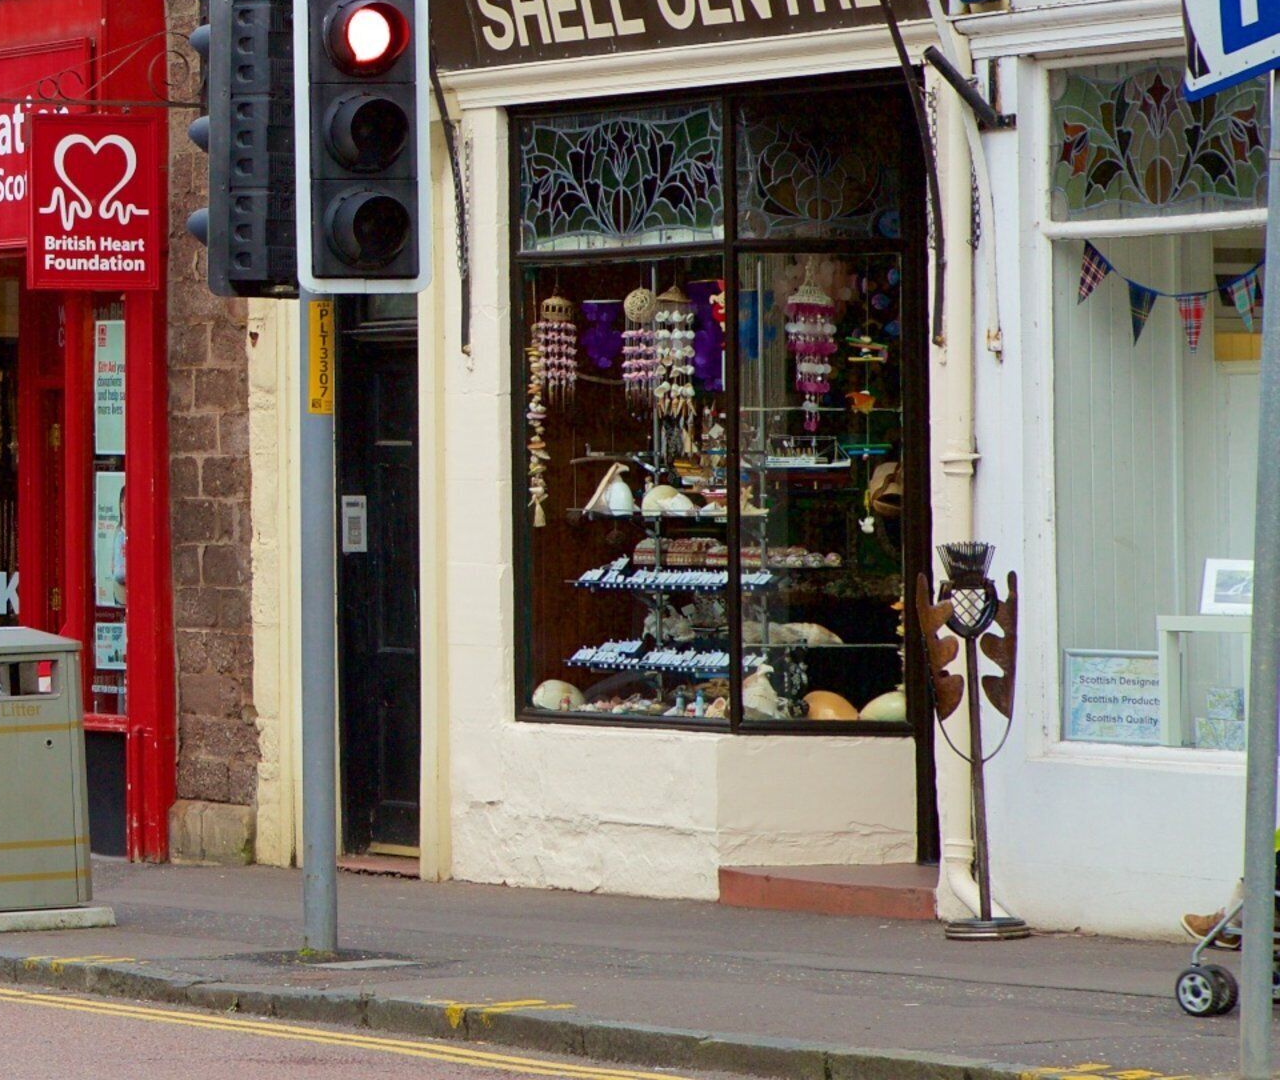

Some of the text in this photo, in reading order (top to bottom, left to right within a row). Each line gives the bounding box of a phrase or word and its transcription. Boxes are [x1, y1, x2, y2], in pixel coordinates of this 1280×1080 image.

[44, 235, 145, 251] British Heart
[44, 254, 146, 271] Foundation
[1080, 675, 1116, 684] Scottish
[1081, 694, 1119, 704] Scottish
[1, 702, 41, 718] Litter
[1085, 713, 1159, 728] Scottish Quality
